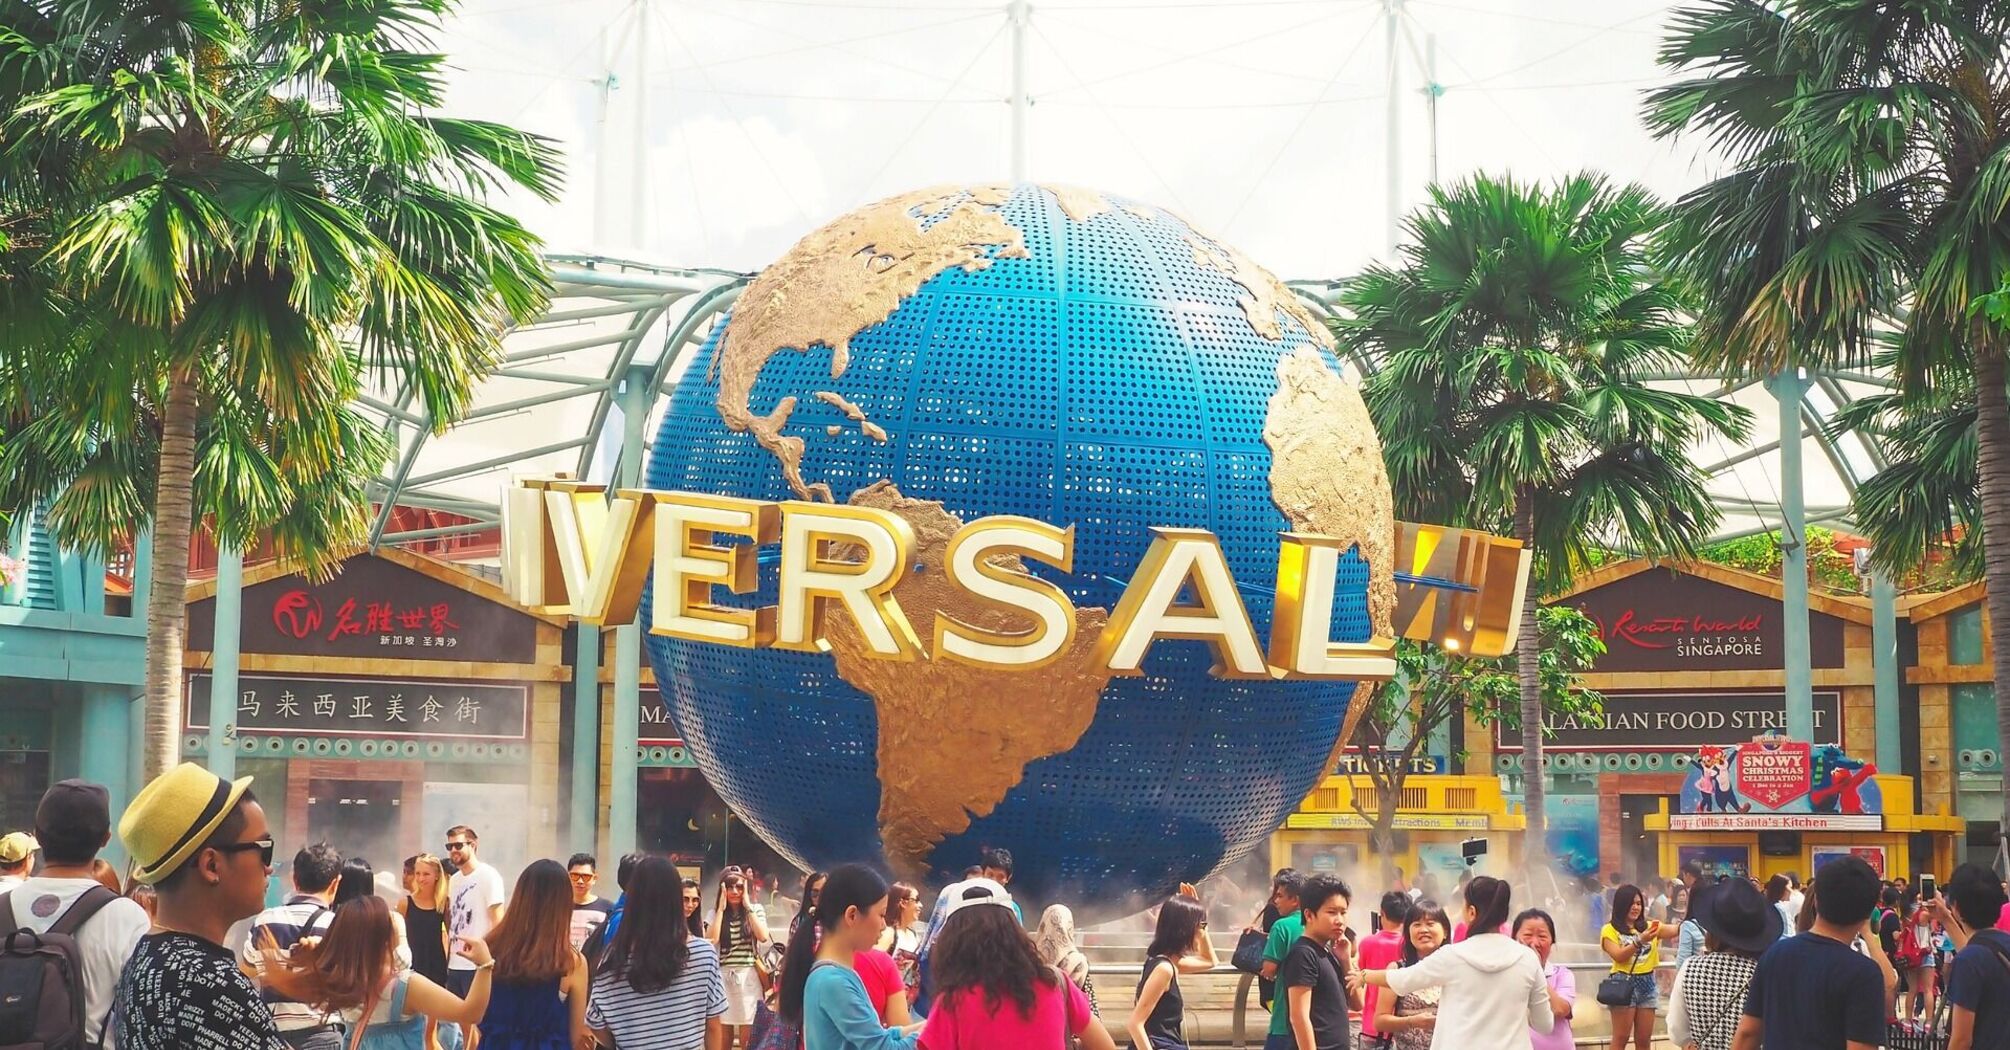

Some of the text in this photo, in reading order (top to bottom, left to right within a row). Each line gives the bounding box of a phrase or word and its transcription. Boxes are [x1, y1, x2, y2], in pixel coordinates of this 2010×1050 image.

[328, 597, 459, 641] 名胜世界
[1693, 615, 1762, 633] World
[379, 635, 416, 647] 新加坡
[1677, 636, 1762, 645] SENTOSA
[1677, 644, 1762, 656] SINGAPORE
[238, 690, 481, 724] 马来西亚美食街
[1656, 711, 1725, 730] FOOD
[1731, 710, 1826, 729] STRET
[1742, 755, 1804, 767] SNOWY
[1742, 767, 1804, 775] CHRISTMAS
[1392, 816, 1441, 828] ttractions
[1737, 816, 1779, 828] Santa's
[1783, 816, 1828, 828] Kitchen
[183, 1003, 205, 1016] DRIZZY
[220, 994, 245, 1012] ROCKY
[178, 1010, 195, 1021] MADE
[211, 999, 244, 1021] MADE ME
[214, 1010, 226, 1020] DO
[248, 1011, 261, 1023] DO
[197, 1024, 229, 1047] PHARRELL
[230, 1029, 250, 1045] MADE
[239, 1024, 262, 1044] YEEZUS
[193, 1034, 214, 1049] MADE
